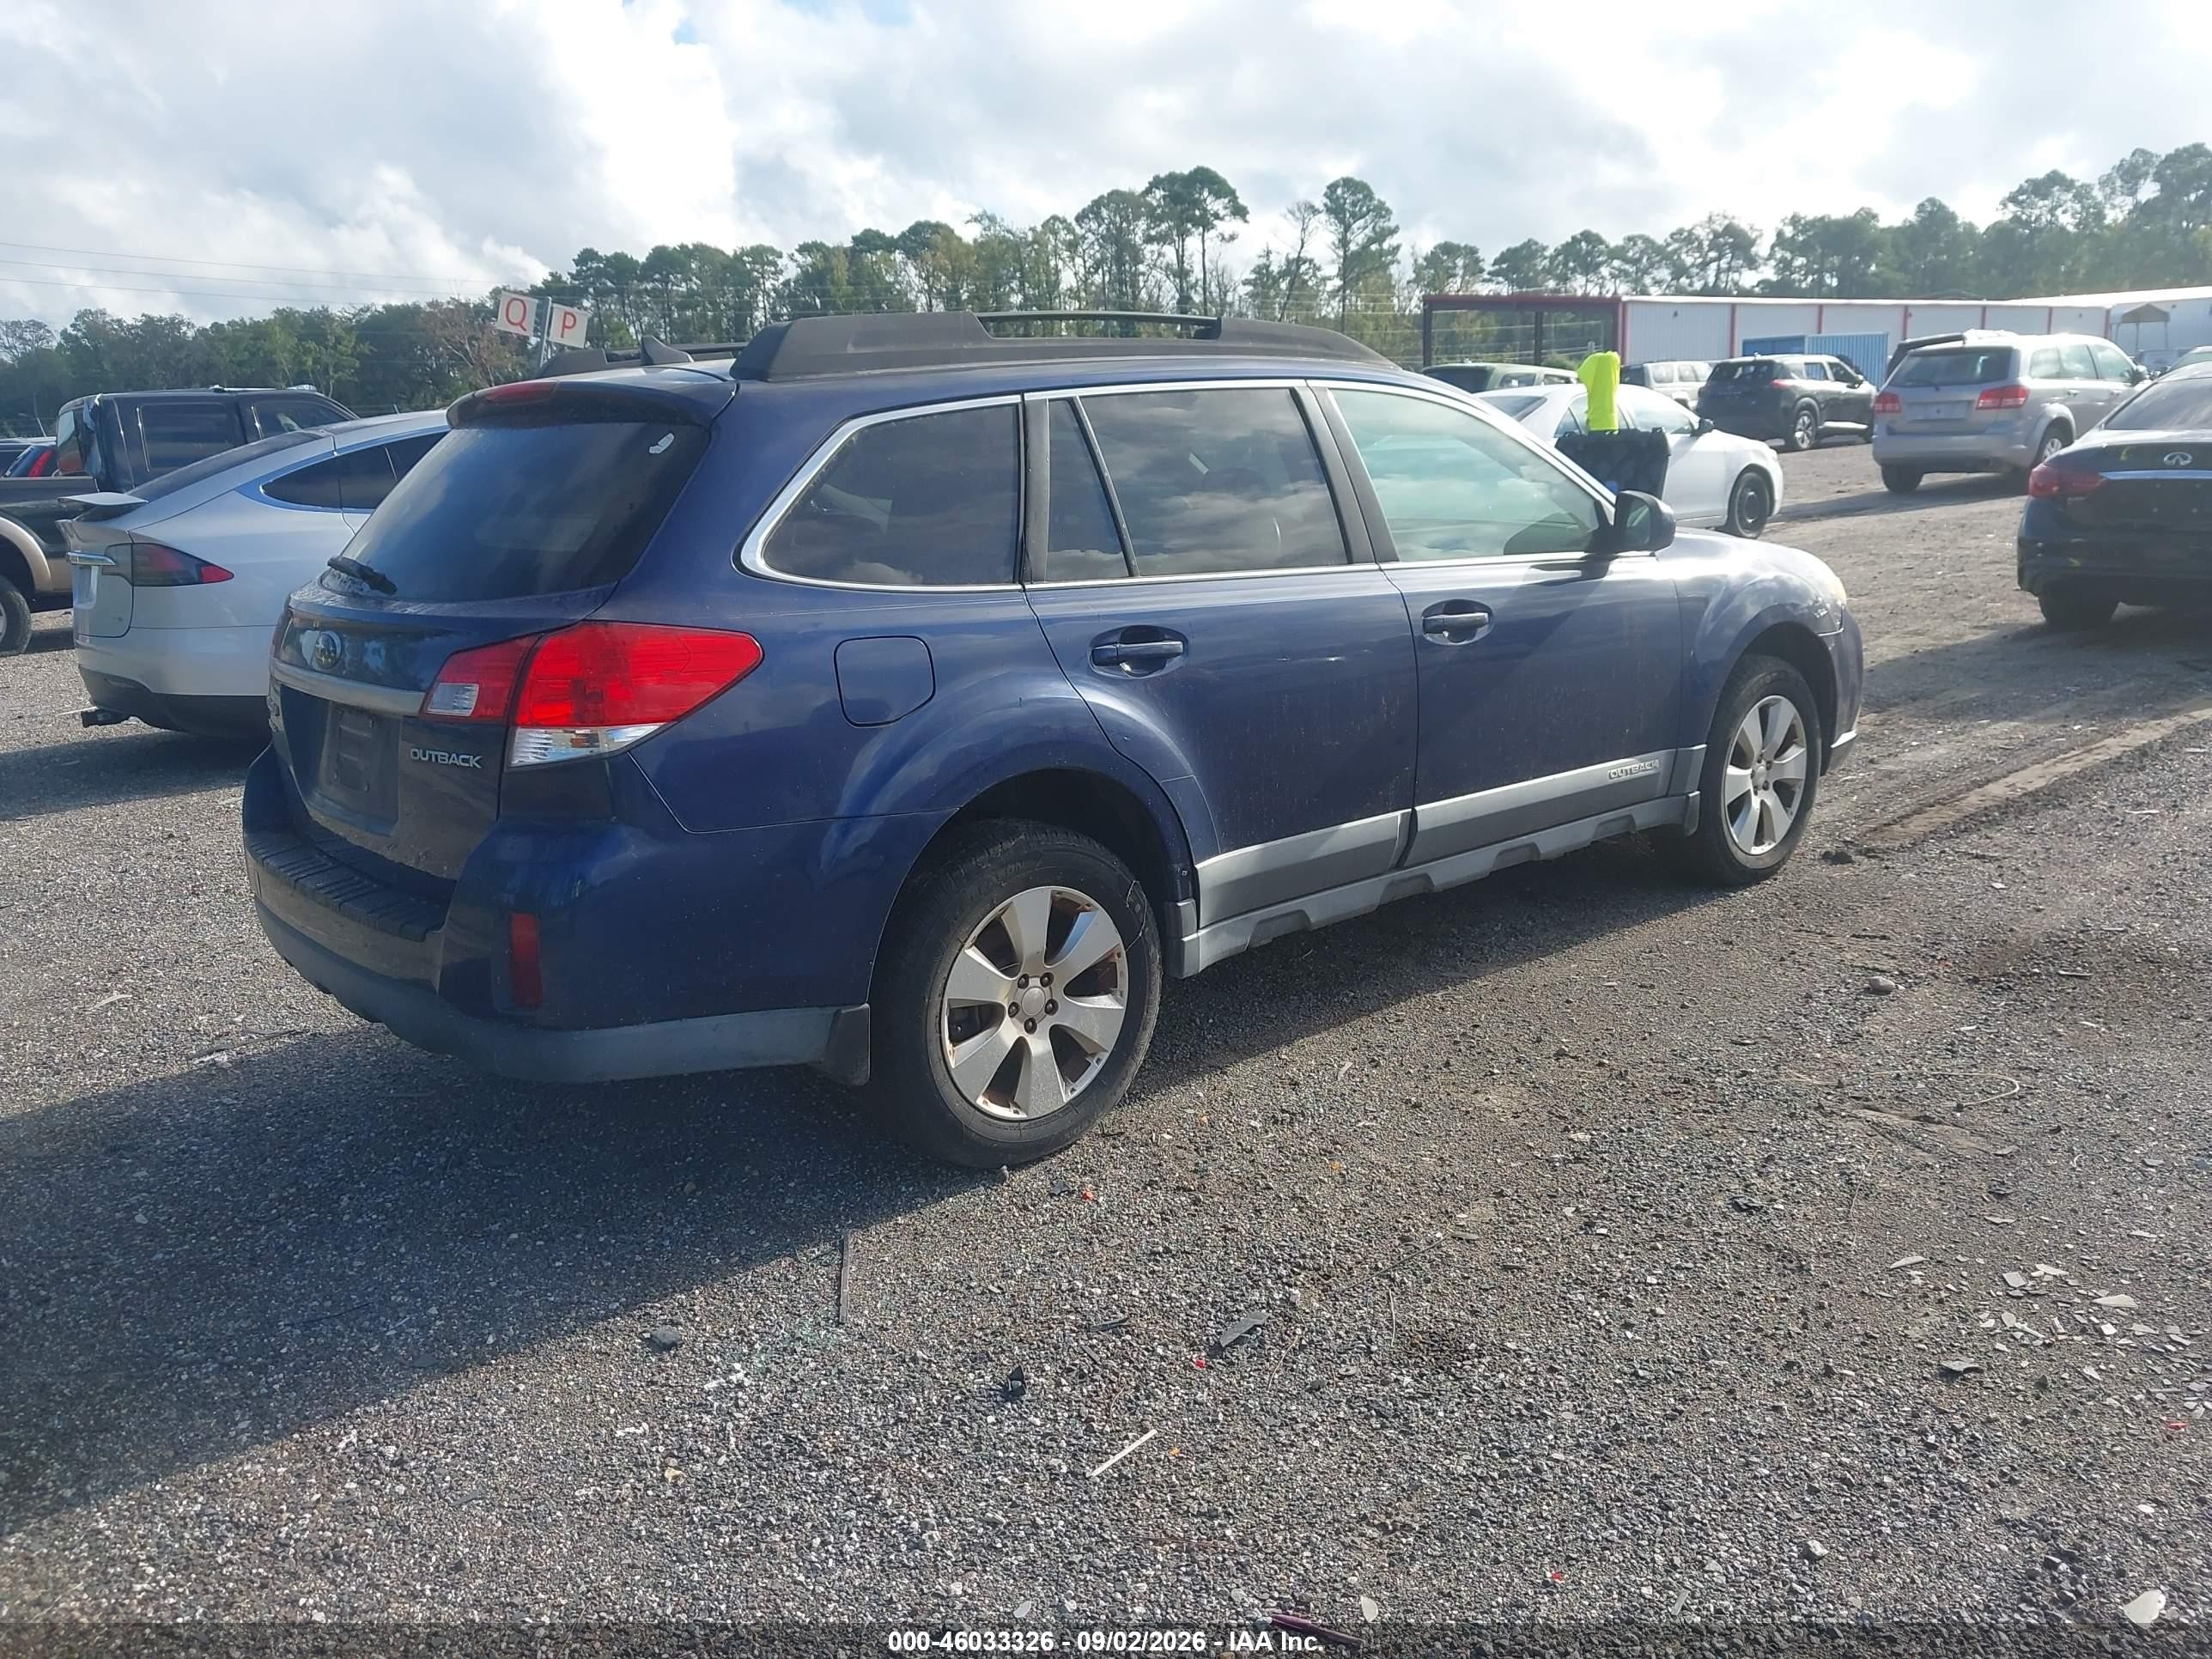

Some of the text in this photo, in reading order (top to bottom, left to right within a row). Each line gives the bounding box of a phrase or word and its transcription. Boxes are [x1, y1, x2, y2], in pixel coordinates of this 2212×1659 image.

[505, 297, 527, 331] Q
[560, 310, 578, 338] P
[410, 748, 483, 769] OUTBACK
[1608, 760, 1660, 781] OUTBACK
